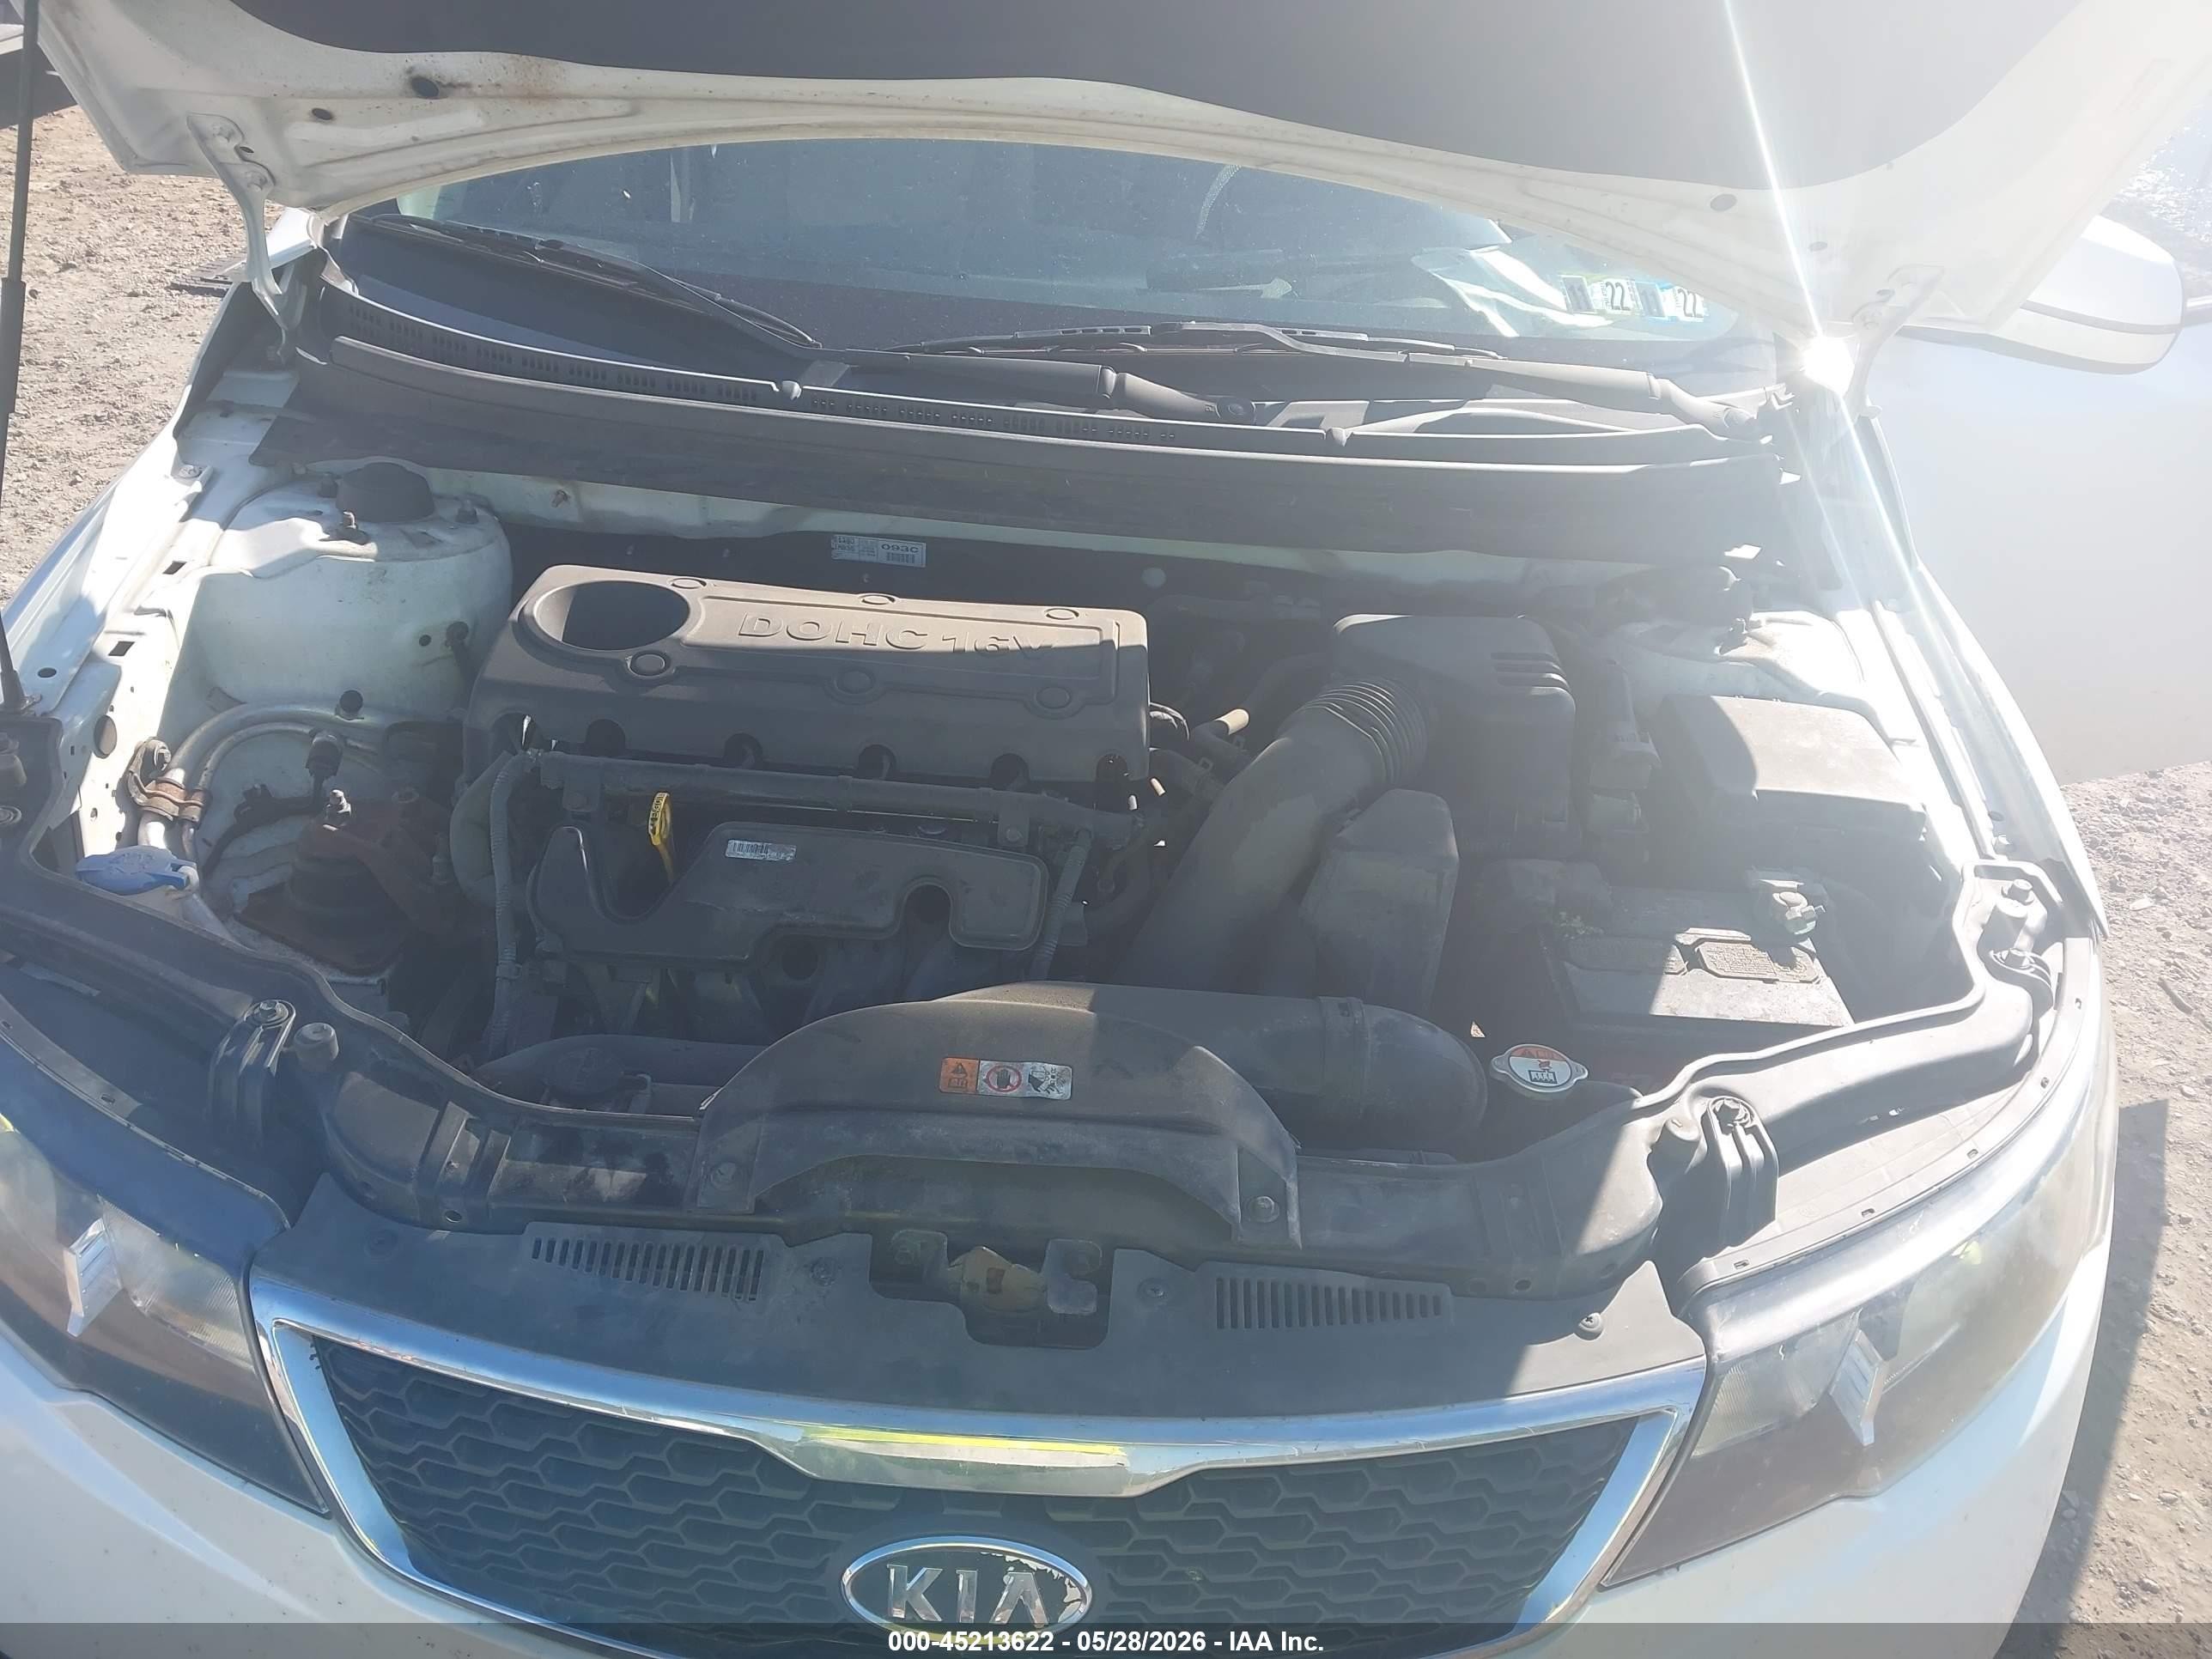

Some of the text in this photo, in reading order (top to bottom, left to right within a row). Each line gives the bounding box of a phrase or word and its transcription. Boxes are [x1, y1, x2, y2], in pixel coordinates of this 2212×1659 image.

[1606, 282, 1631, 311] 22
[1678, 289, 1704, 318] 22
[881, 543, 919, 553] 093C
[738, 611, 1054, 661] DOHC 16V
[886, 1564, 1050, 1628] KIA
